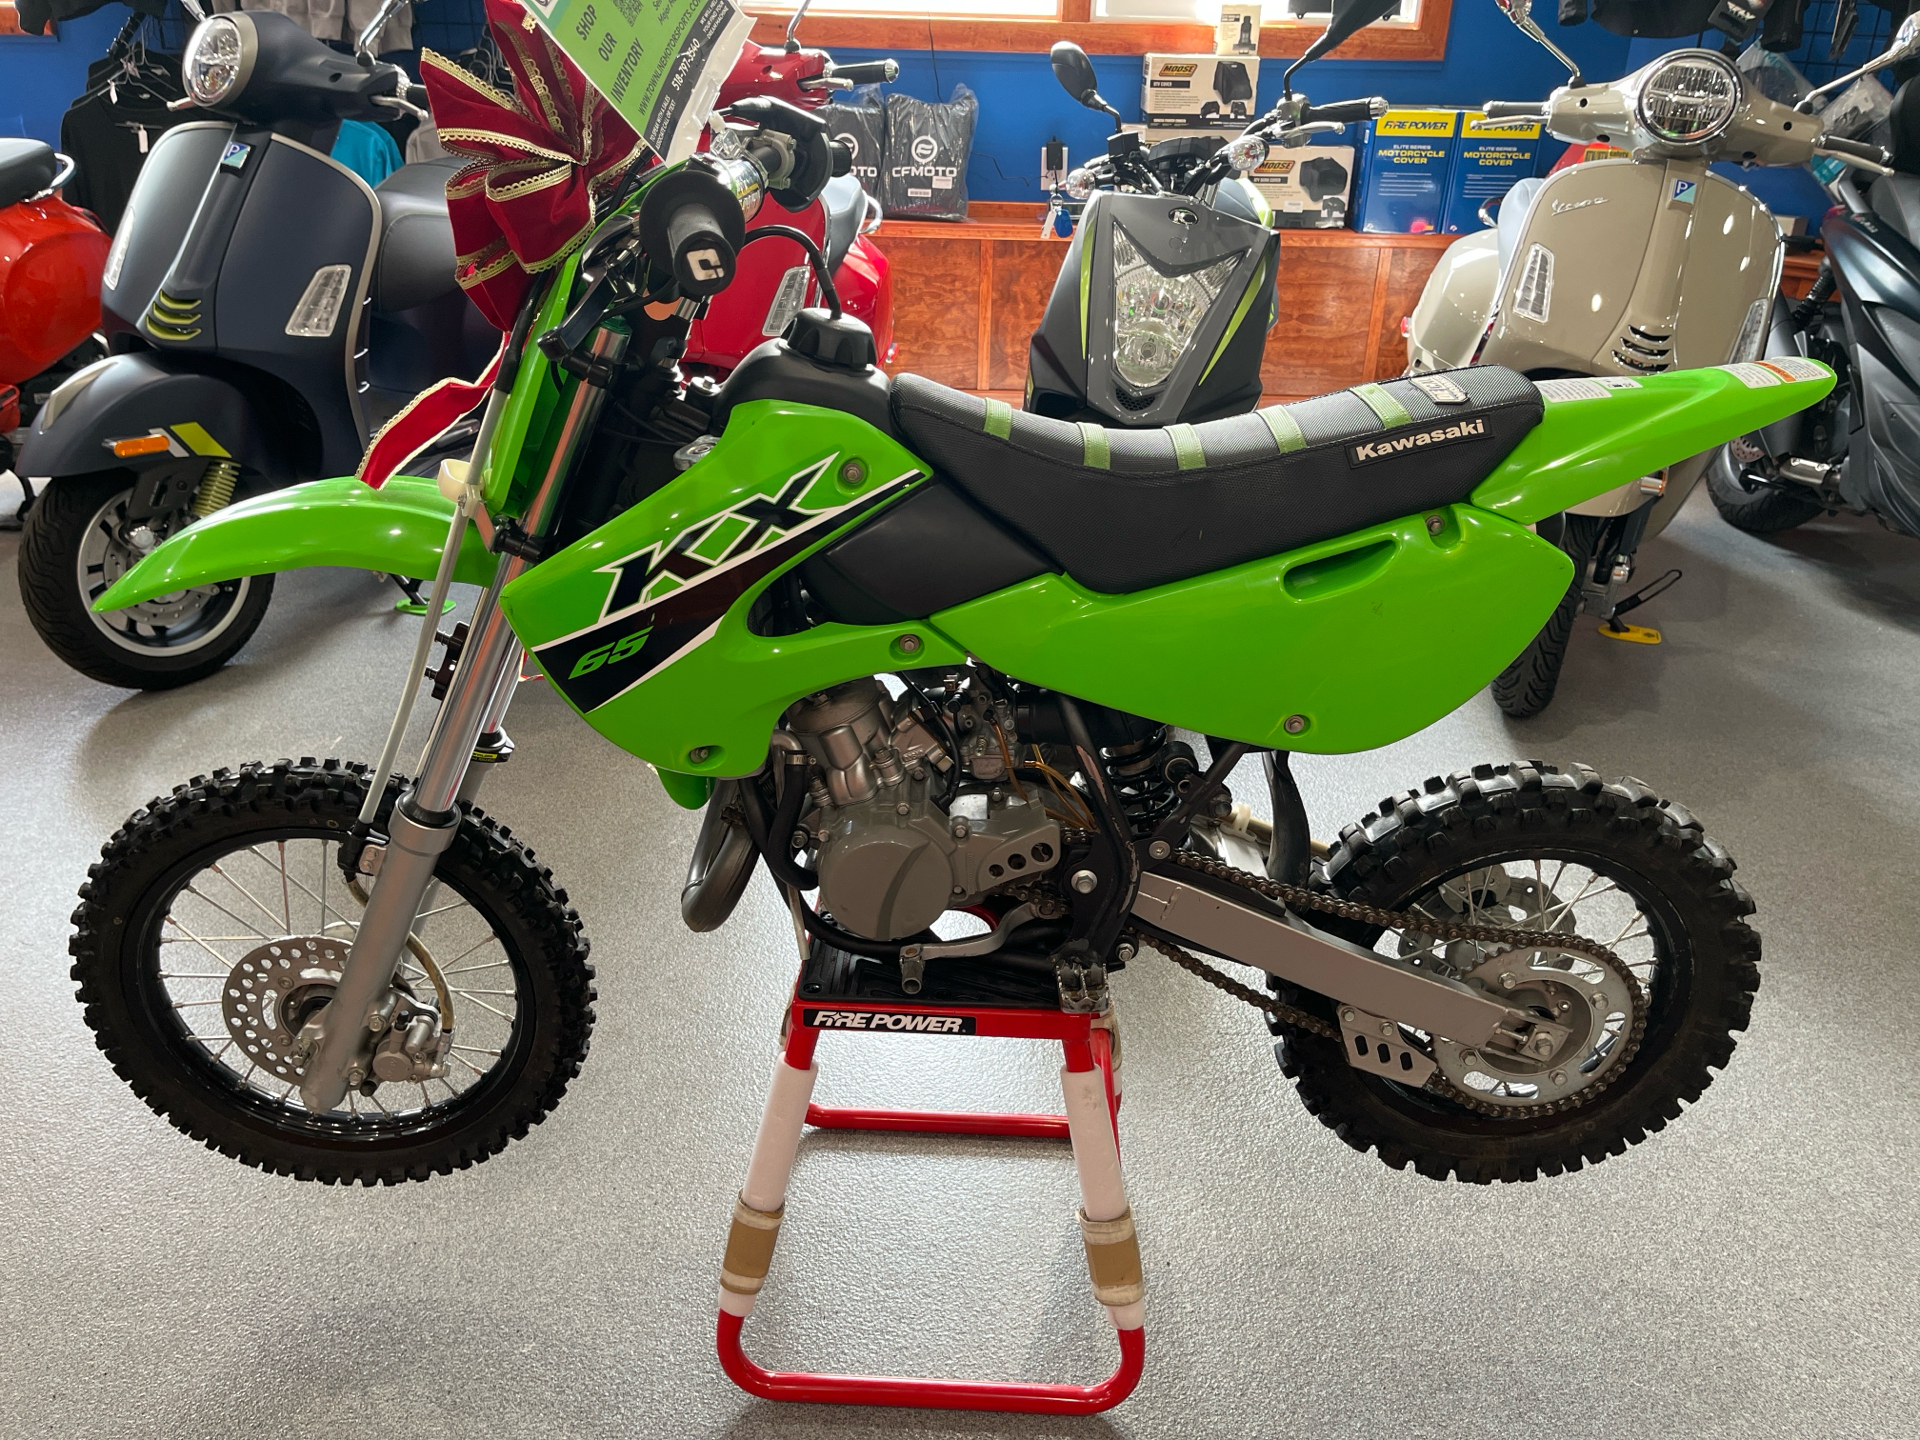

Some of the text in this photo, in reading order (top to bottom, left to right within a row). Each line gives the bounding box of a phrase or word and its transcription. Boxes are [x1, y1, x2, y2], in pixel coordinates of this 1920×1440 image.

[576, 4, 597, 41] SHOP
[700, 16, 706, 25] WE
[703, 20, 711, 33] YOUR
[709, 10, 718, 23] FIND
[706, 5, 729, 39] DREAM MACHINE
[598, 32, 617, 62] OUR
[637, 0, 702, 117] WWW.TOWNLINEMOTORSPORTS.CO
[610, 37, 644, 104] INVENTORY
[671, 38, 701, 91] 518-797-3540
[1163, 65, 1194, 73] MOOSE
[651, 121, 660, 137] SPEAK
[661, 94, 671, 110] SALES
[655, 127, 665, 150] ASSOCIATE
[662, 116, 670, 129] CALL
[668, 98, 676, 111] TEXT
[1408, 121, 1448, 130] POWER
[1259, 161, 1293, 170] MOOSE
[1378, 149, 1445, 158] MOTORCYCLE
[1463, 151, 1531, 160] MOTORCYCLE
[891, 166, 957, 177] CFMOTO
[1355, 418, 1485, 461] Kawasaki
[593, 452, 842, 622] KX
[568, 626, 654, 679] 65
[812, 1010, 964, 1033] FIRE POWER
